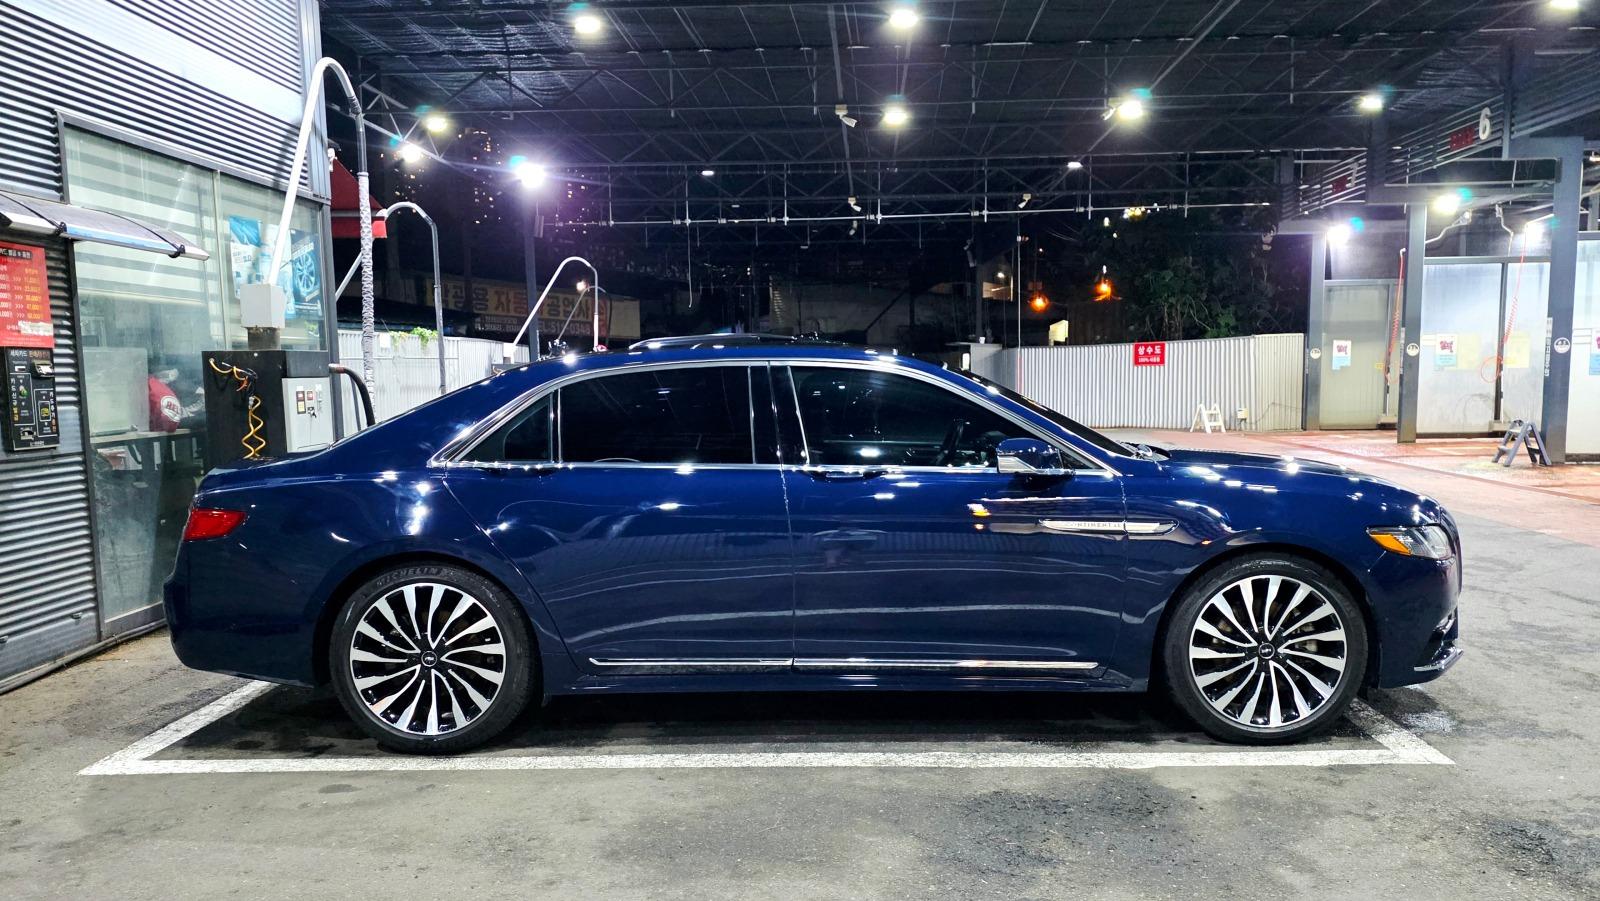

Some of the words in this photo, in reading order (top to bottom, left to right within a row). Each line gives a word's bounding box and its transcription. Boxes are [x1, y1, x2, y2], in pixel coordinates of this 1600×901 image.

[1479, 107, 1491, 140] 6
[1138, 345, 1162, 355] 상수도
[376, 567, 438, 587] MICHELIN
